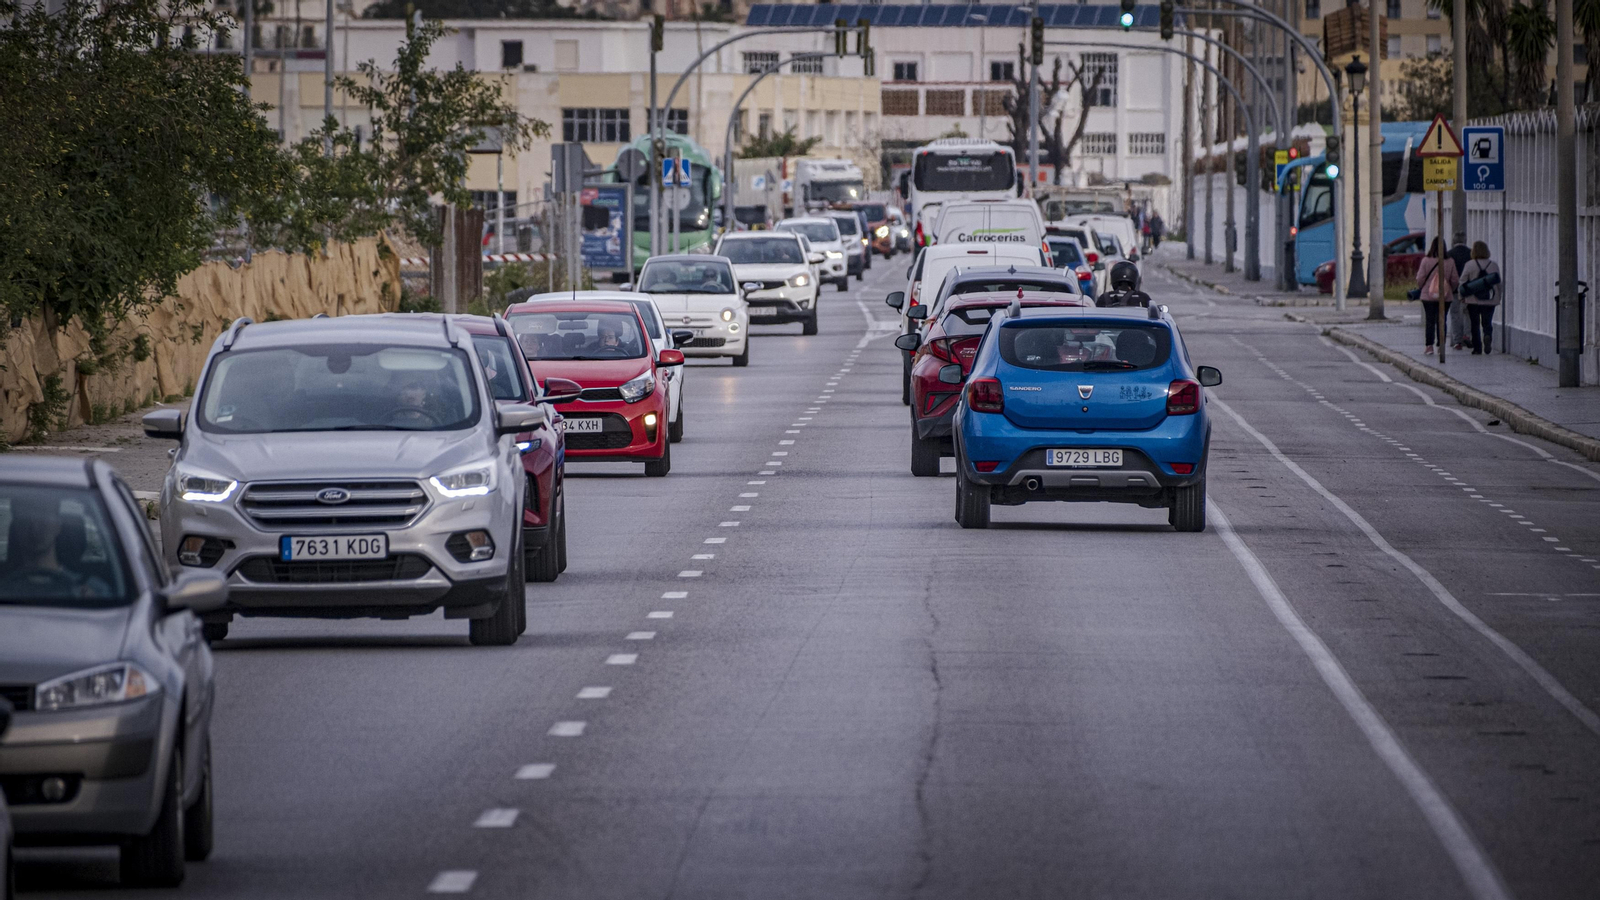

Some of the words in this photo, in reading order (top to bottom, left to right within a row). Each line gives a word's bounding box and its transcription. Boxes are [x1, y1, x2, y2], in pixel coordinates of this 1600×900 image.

[578, 420, 598, 430] KXH
[1056, 451, 1090, 464] 9729
[1094, 451, 1120, 464] LBG
[323, 491, 342, 499] Ford
[296, 539, 339, 556] 7631
[347, 538, 381, 555] KDG
